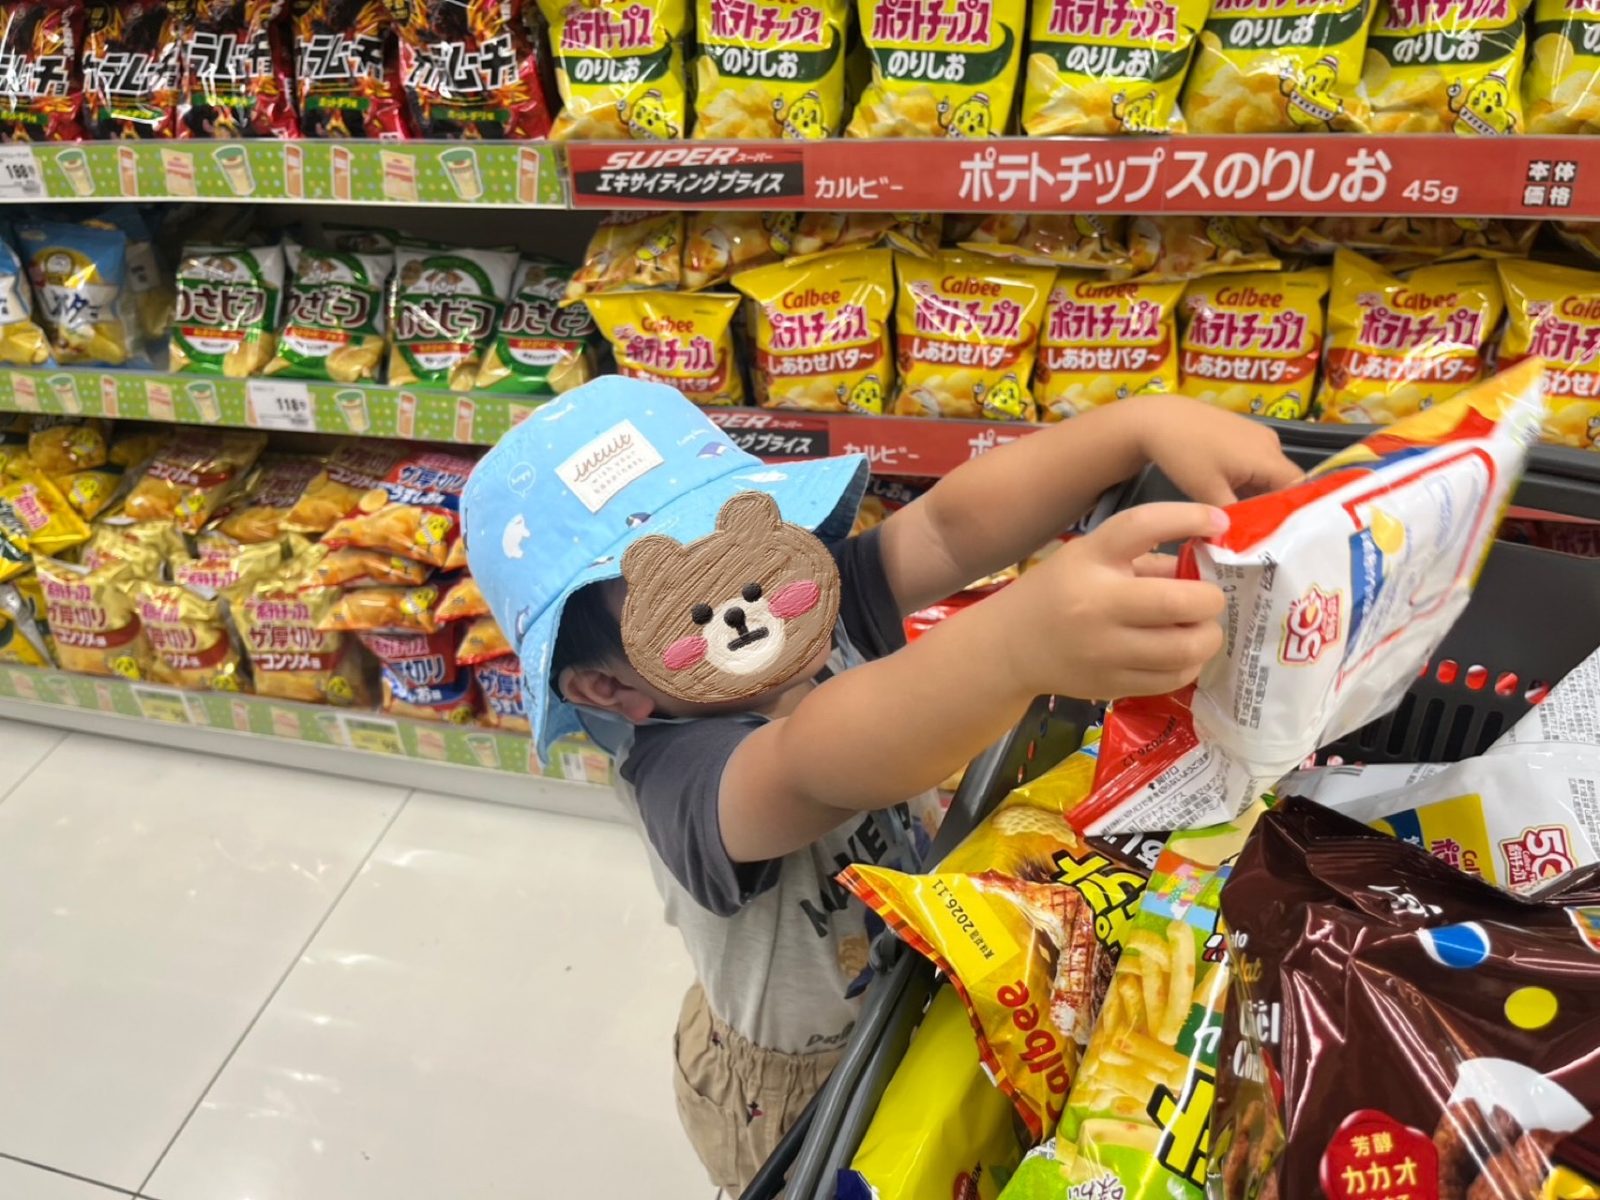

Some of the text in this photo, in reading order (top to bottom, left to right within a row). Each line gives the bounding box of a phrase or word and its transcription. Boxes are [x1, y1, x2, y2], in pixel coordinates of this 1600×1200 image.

[560, 5, 655, 49] ポテトップス
[710, 0, 823, 44] ポテトチップス
[872, 0, 992, 45] ポテトチップス
[1048, 0, 1179, 44] ポテトチップス
[1229, 15, 1316, 47] のりしお
[186, 31, 274, 79] ラムーチョ
[296, 33, 384, 82] ラムーチョ
[722, 46, 799, 79] のりしお
[1065, 45, 1151, 77] のりしお
[1392, 29, 1482, 63] のりしお
[574, 57, 642, 83] のりしお
[887, 50, 966, 82] のりしお
[601, 146, 774, 171] SUPER スーパー
[1528, 160, 1577, 183] 本体
[595, 171, 785, 195] エキサイティングプライス
[814, 146, 1460, 206] カルビー ポテトチップスのりしお 45g
[1522, 185, 1572, 208] 価格
[782, 287, 841, 310] Calbee
[940, 274, 1003, 297] Calbee
[1215, 285, 1284, 309] Calbee
[769, 304, 869, 349] ポテトチップス
[915, 294, 1021, 339] ポテトチップス
[1048, 300, 1164, 341] ポテトチップス
[1188, 310, 1307, 351] ポテトチップス
[1358, 306, 1484, 348] ポテトチップス
[842, 443, 922, 466] カルビー
[931, 878, 975, 933] 2026.11
[1349, 1130, 1395, 1159] 芳醇
[1340, 1155, 1419, 1195] カカオ
